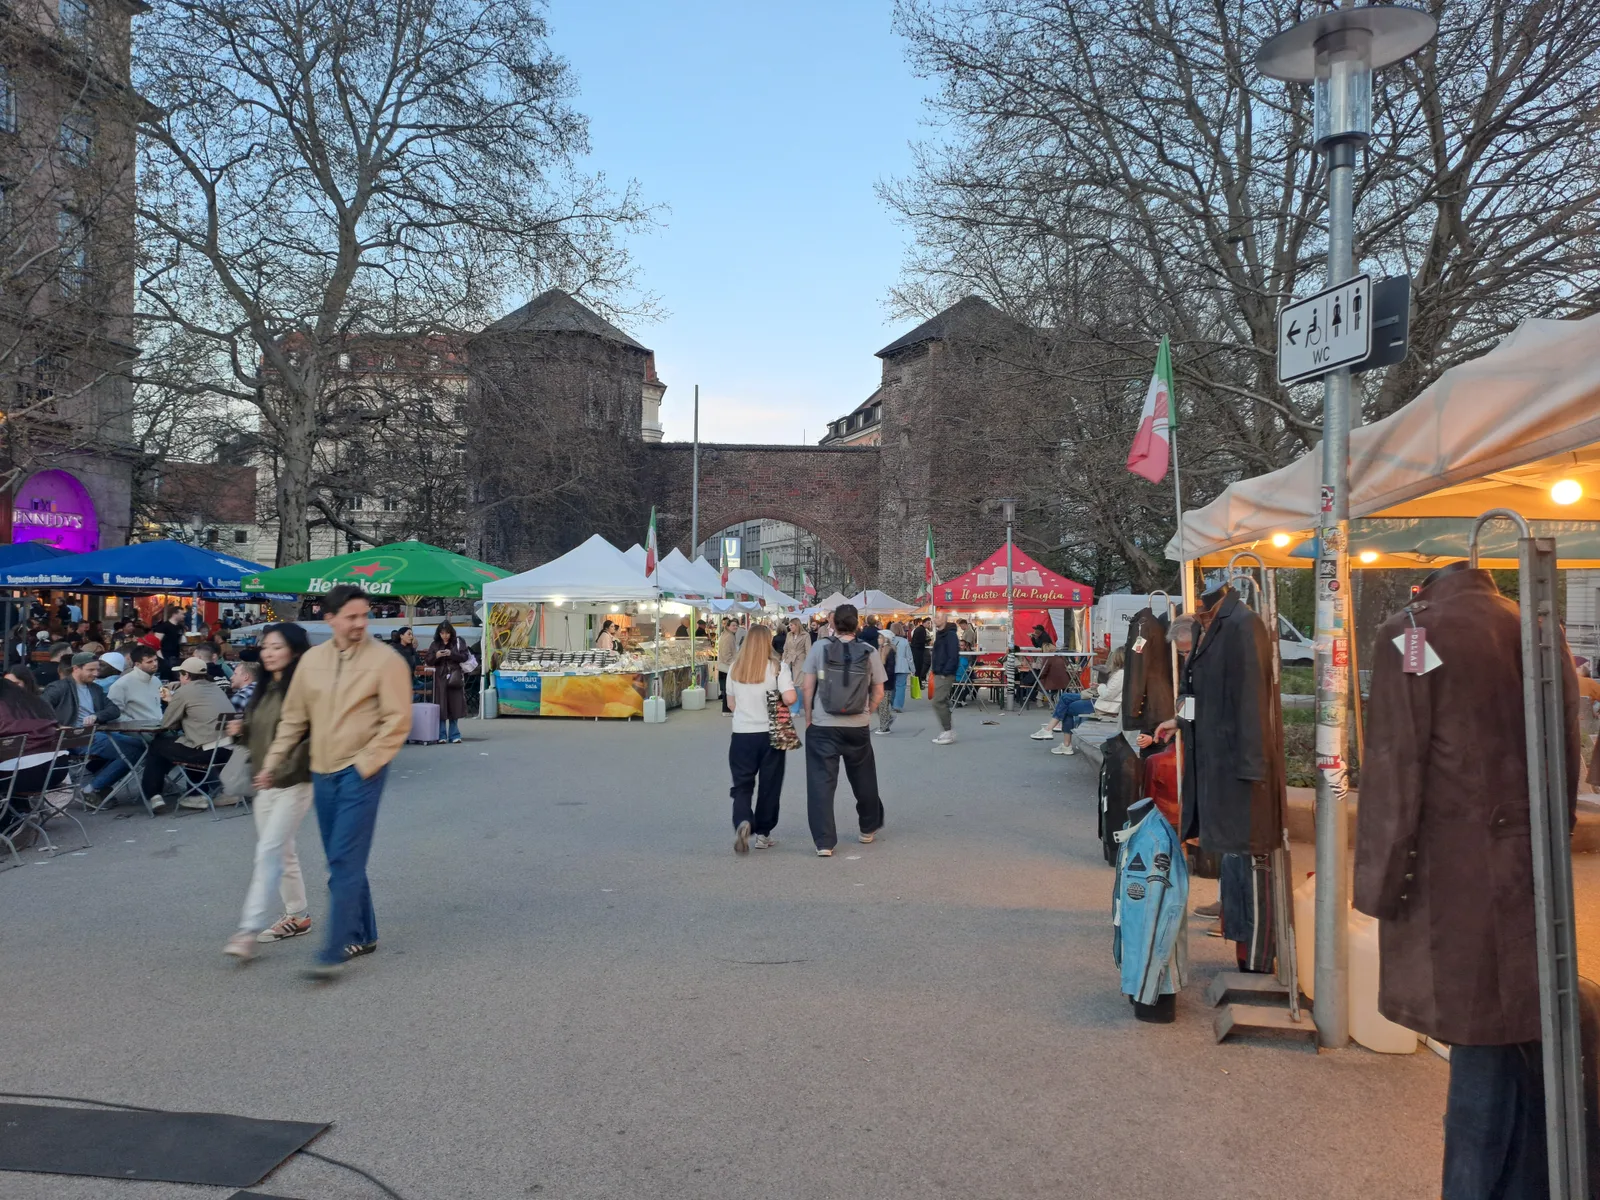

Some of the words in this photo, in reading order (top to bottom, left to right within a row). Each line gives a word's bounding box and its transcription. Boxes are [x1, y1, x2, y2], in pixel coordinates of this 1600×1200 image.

[1313, 346, 1330, 365] WC
[725, 540, 737, 556] U
[961, 588, 970, 600] Il
[972, 590, 1000, 602] gusto
[1002, 588, 1028, 599] dlla
[1030, 588, 1064, 602] Puglia
[1410, 634, 1418, 667] DALLAS
